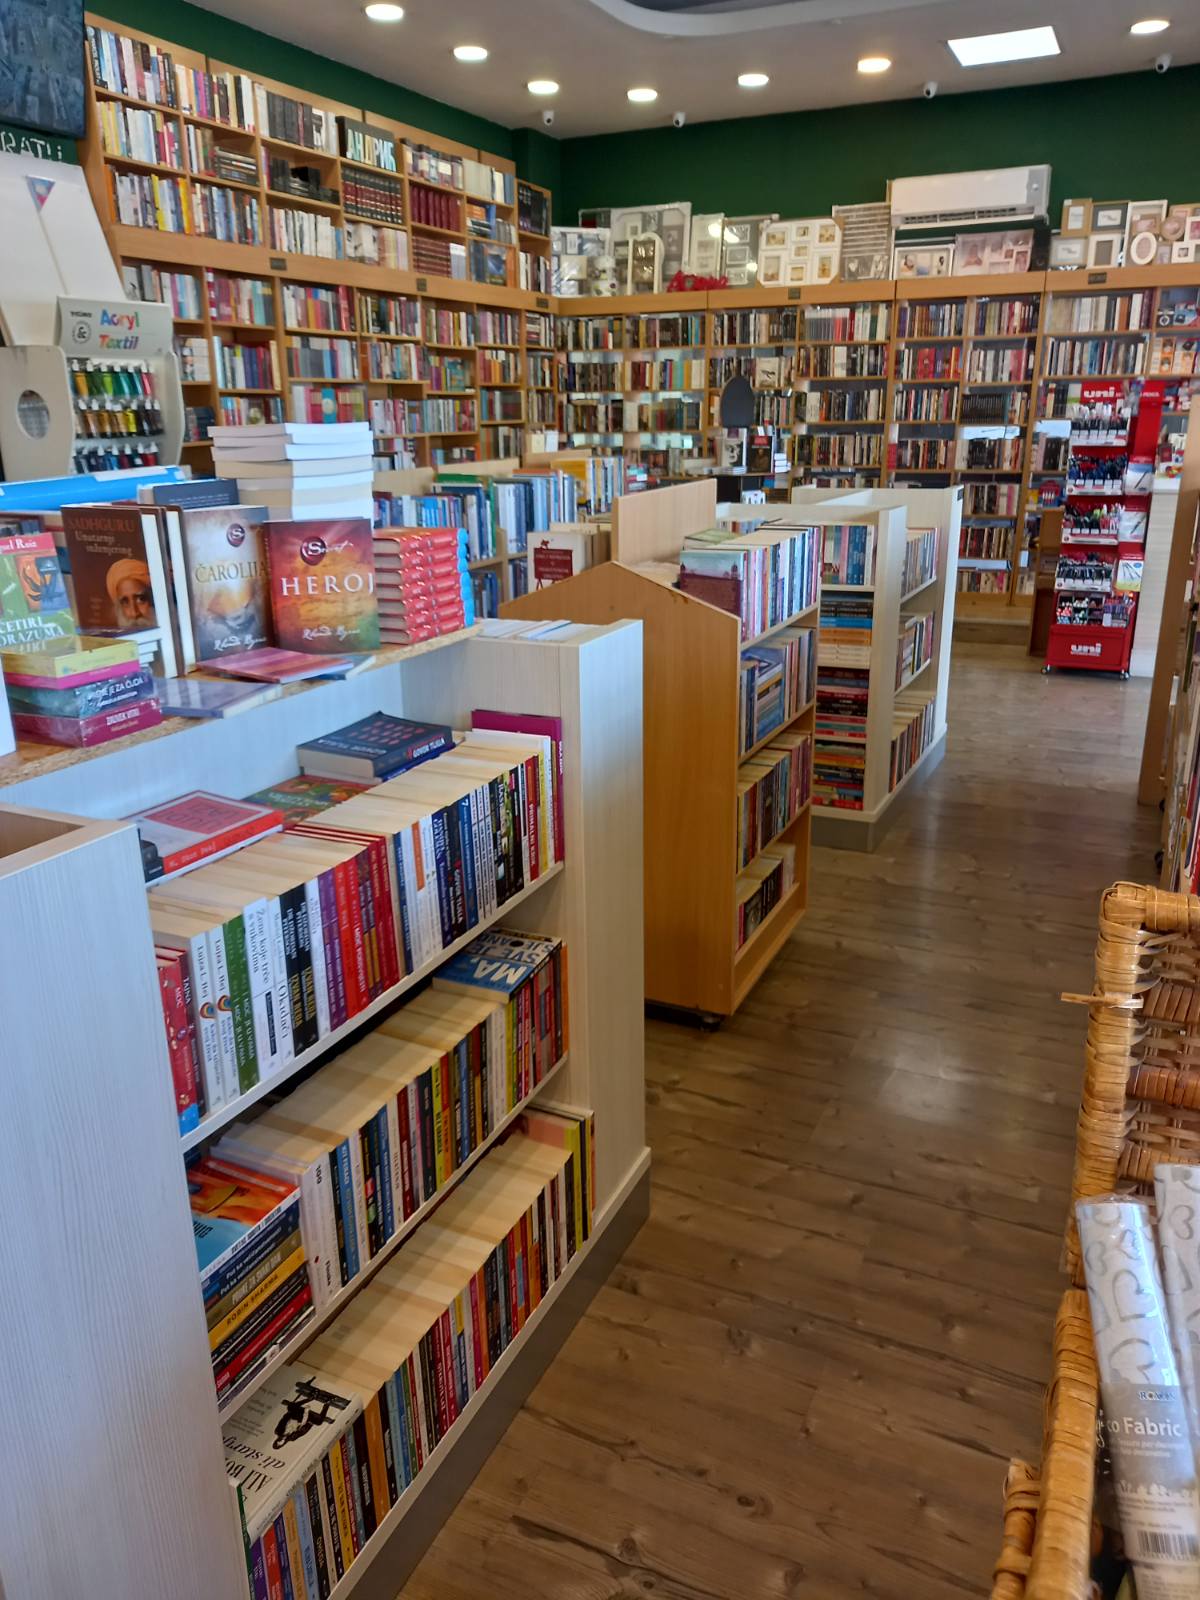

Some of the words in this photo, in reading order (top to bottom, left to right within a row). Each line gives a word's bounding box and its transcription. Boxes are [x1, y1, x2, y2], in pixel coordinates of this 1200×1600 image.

[100, 309, 139, 330] Acryl
[99, 334, 139, 349] Textil
[1084, 387, 1115, 398] uni
[281, 573, 374, 595] HEROJ
[1071, 644, 1102, 654] uni
[527, 802, 535, 845] PRIMALNI
[255, 908, 267, 938] Žene
[258, 938, 267, 961] koje
[290, 973, 300, 1000] IZVAN
[303, 966, 313, 993] IZVAN
[277, 984, 290, 1039] Okidači
[226, 1303, 249, 1325] ROBIN
[1122, 1416, 1182, 1438] Fabric
